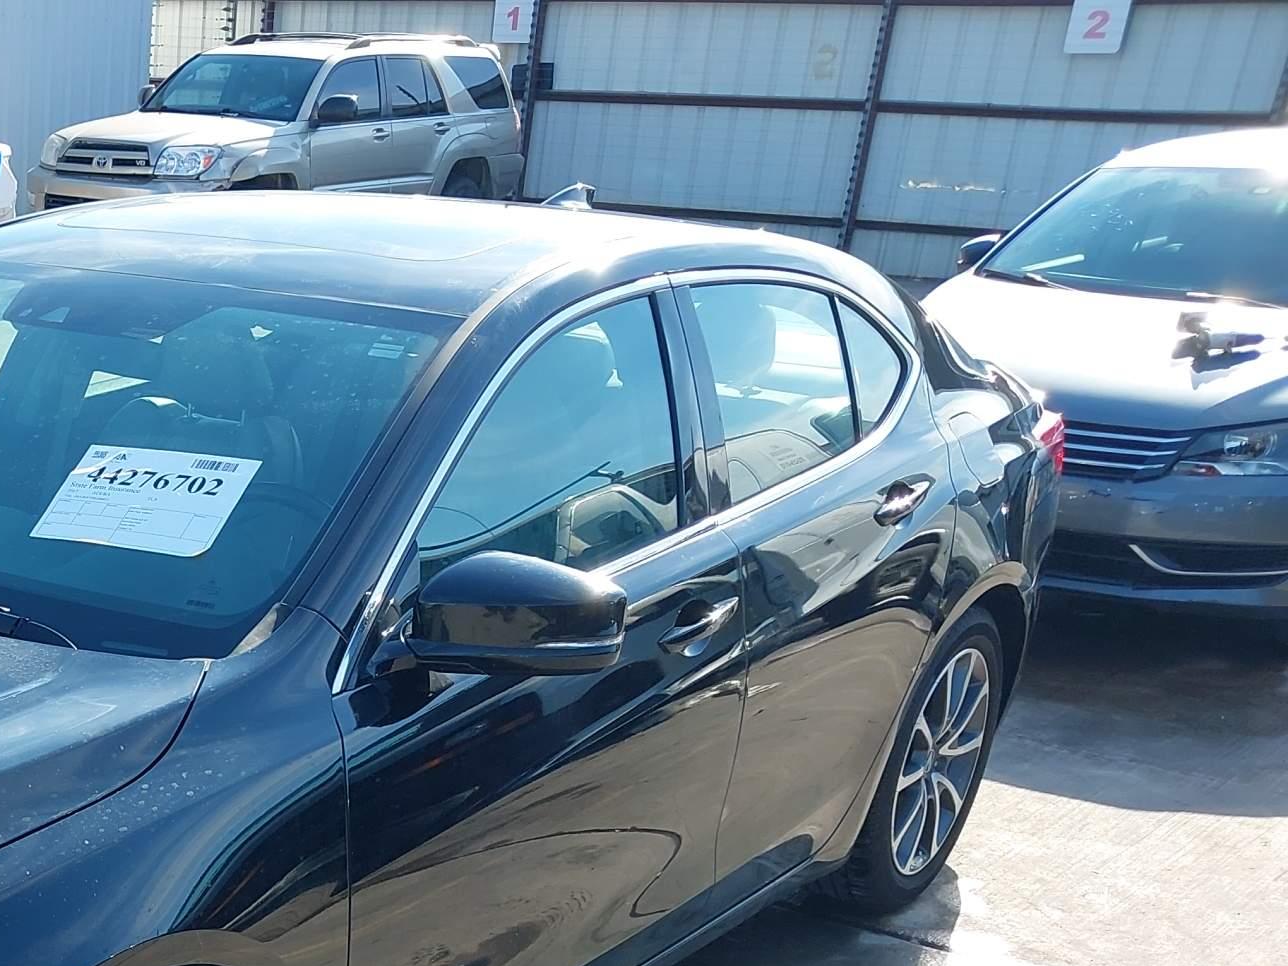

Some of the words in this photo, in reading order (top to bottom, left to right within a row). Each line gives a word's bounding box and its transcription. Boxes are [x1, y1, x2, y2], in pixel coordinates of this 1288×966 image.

[507, 6, 520, 31] 1
[1082, 9, 1110, 39] 2
[70, 481, 88, 489] State
[87, 466, 223, 496] 44276702
